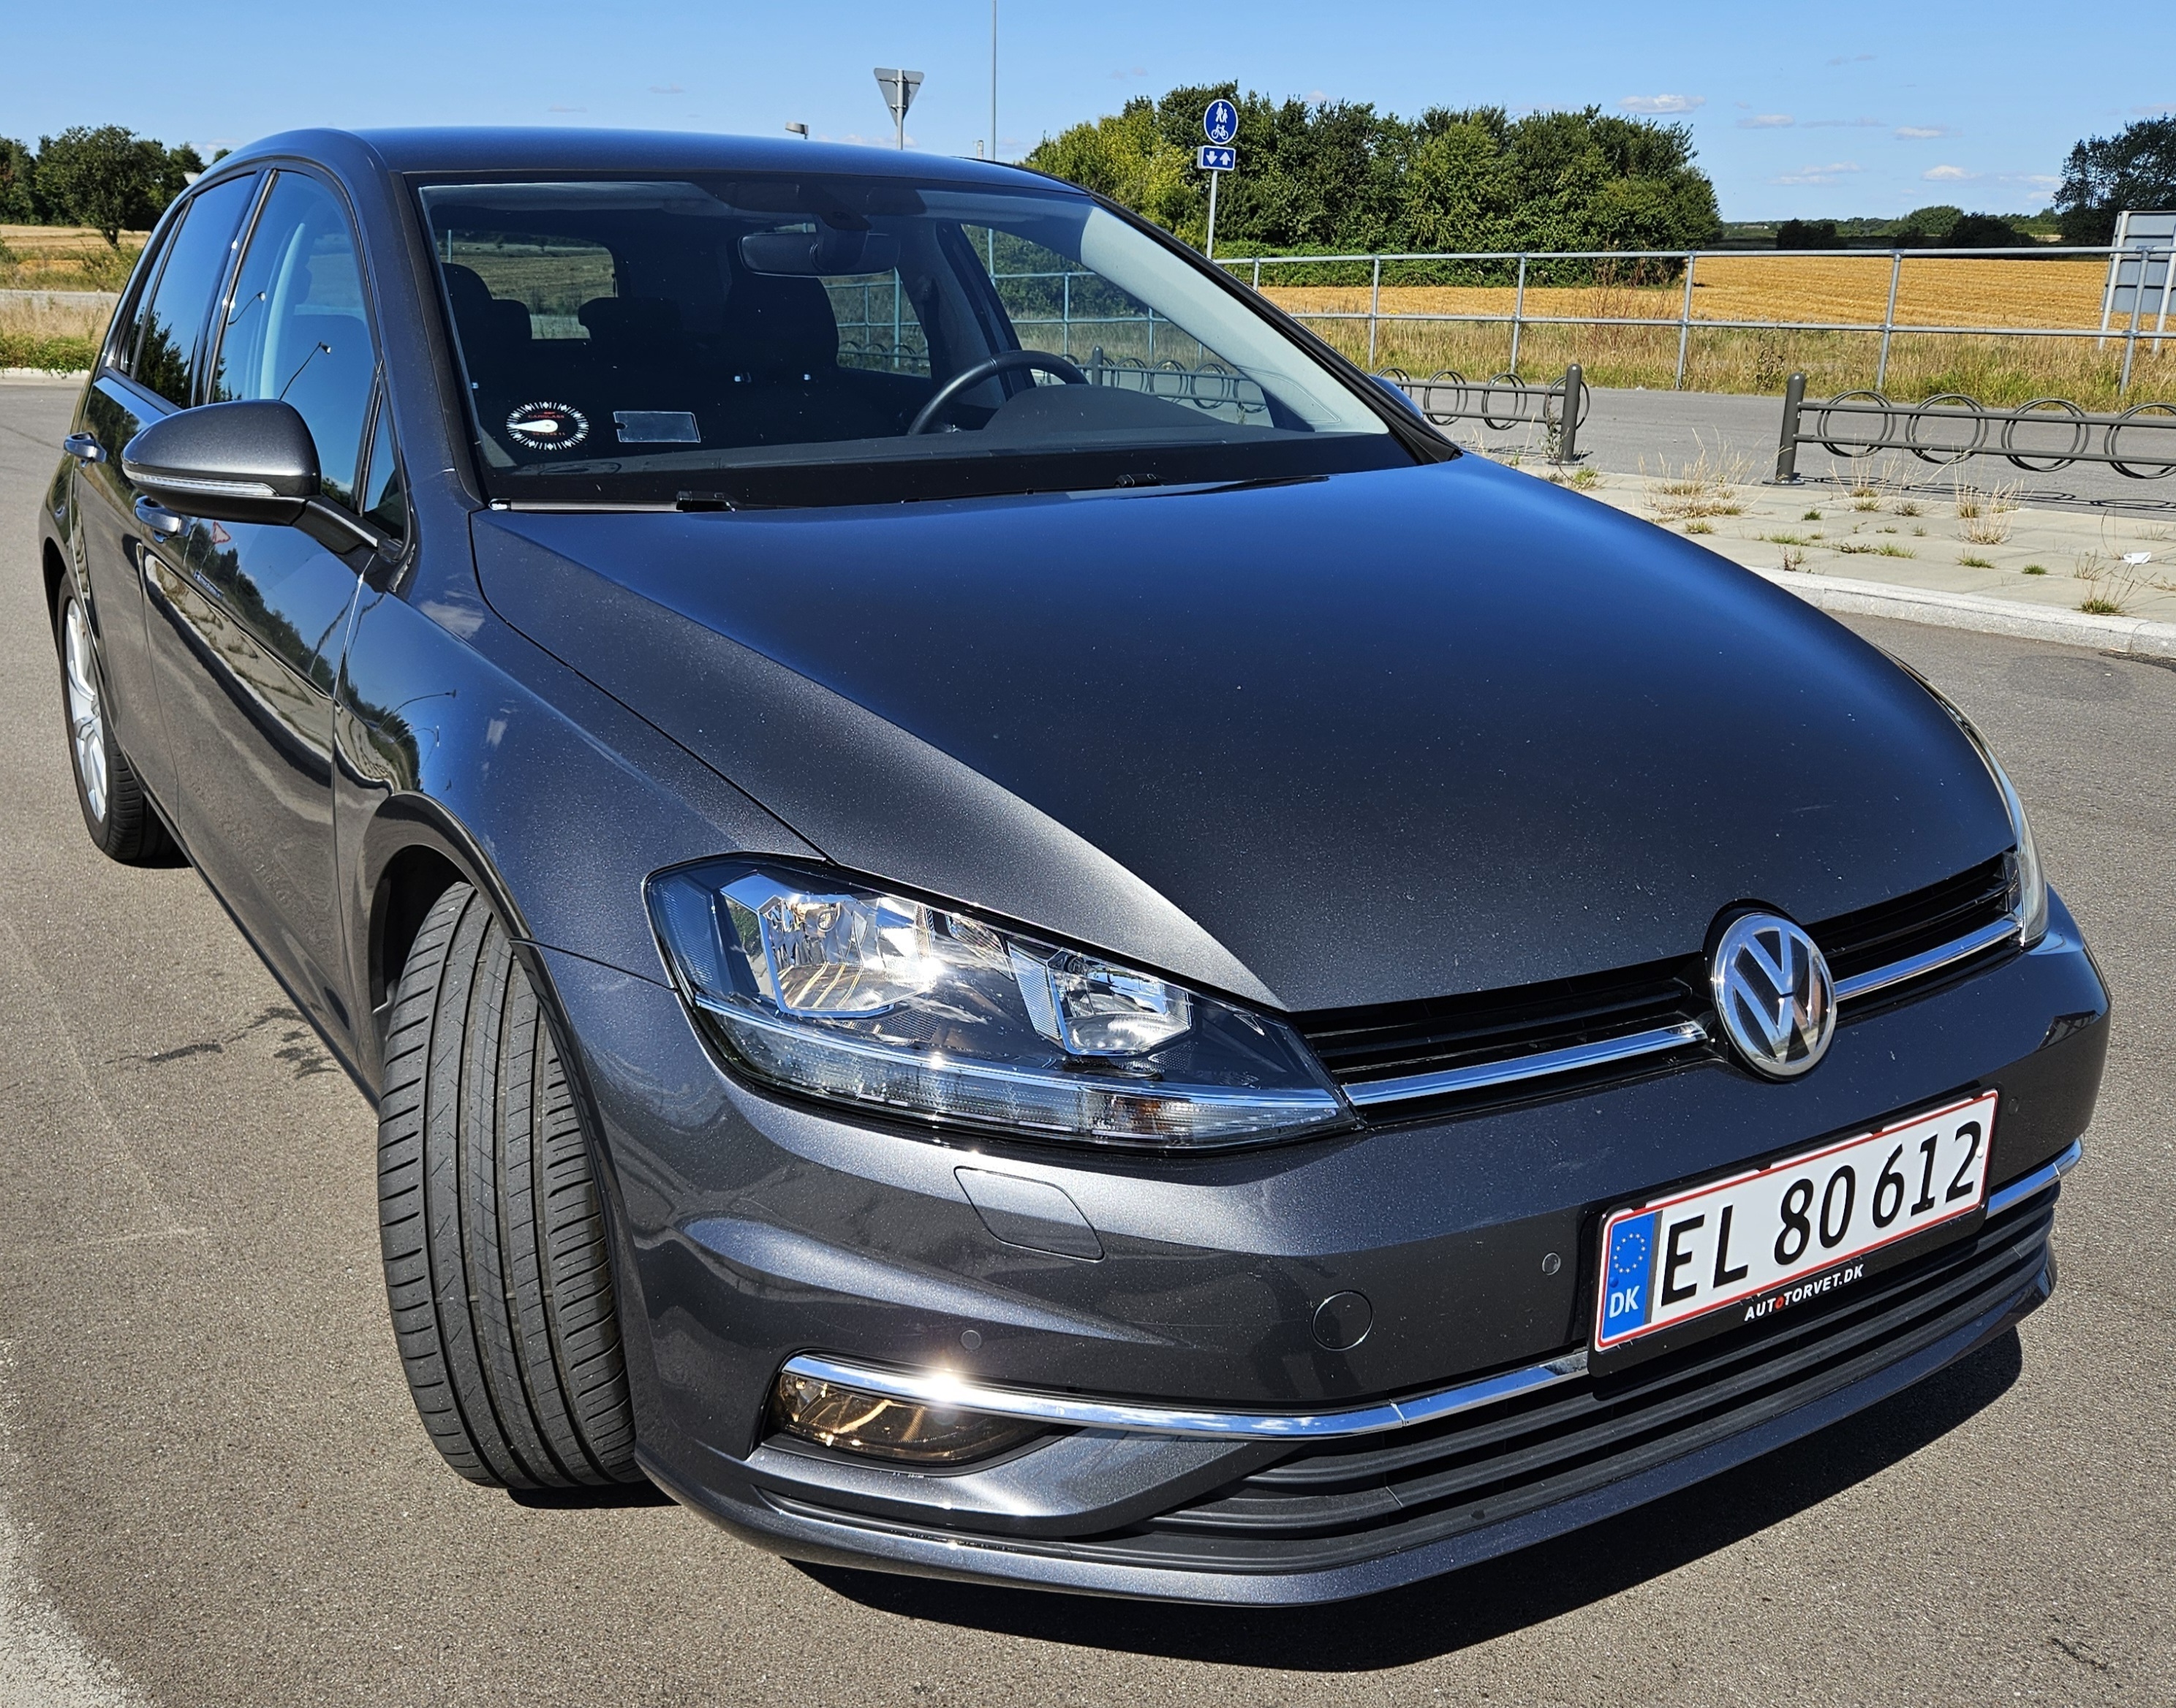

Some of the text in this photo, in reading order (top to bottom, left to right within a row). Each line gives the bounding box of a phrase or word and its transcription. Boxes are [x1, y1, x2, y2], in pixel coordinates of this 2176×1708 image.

[1717, 920, 1831, 1066] VW
[1661, 1120, 1982, 1307] EL 80 612
[1609, 1285, 1640, 1319] DK
[1744, 1263, 1865, 1322] AUTOTORVET.DK
